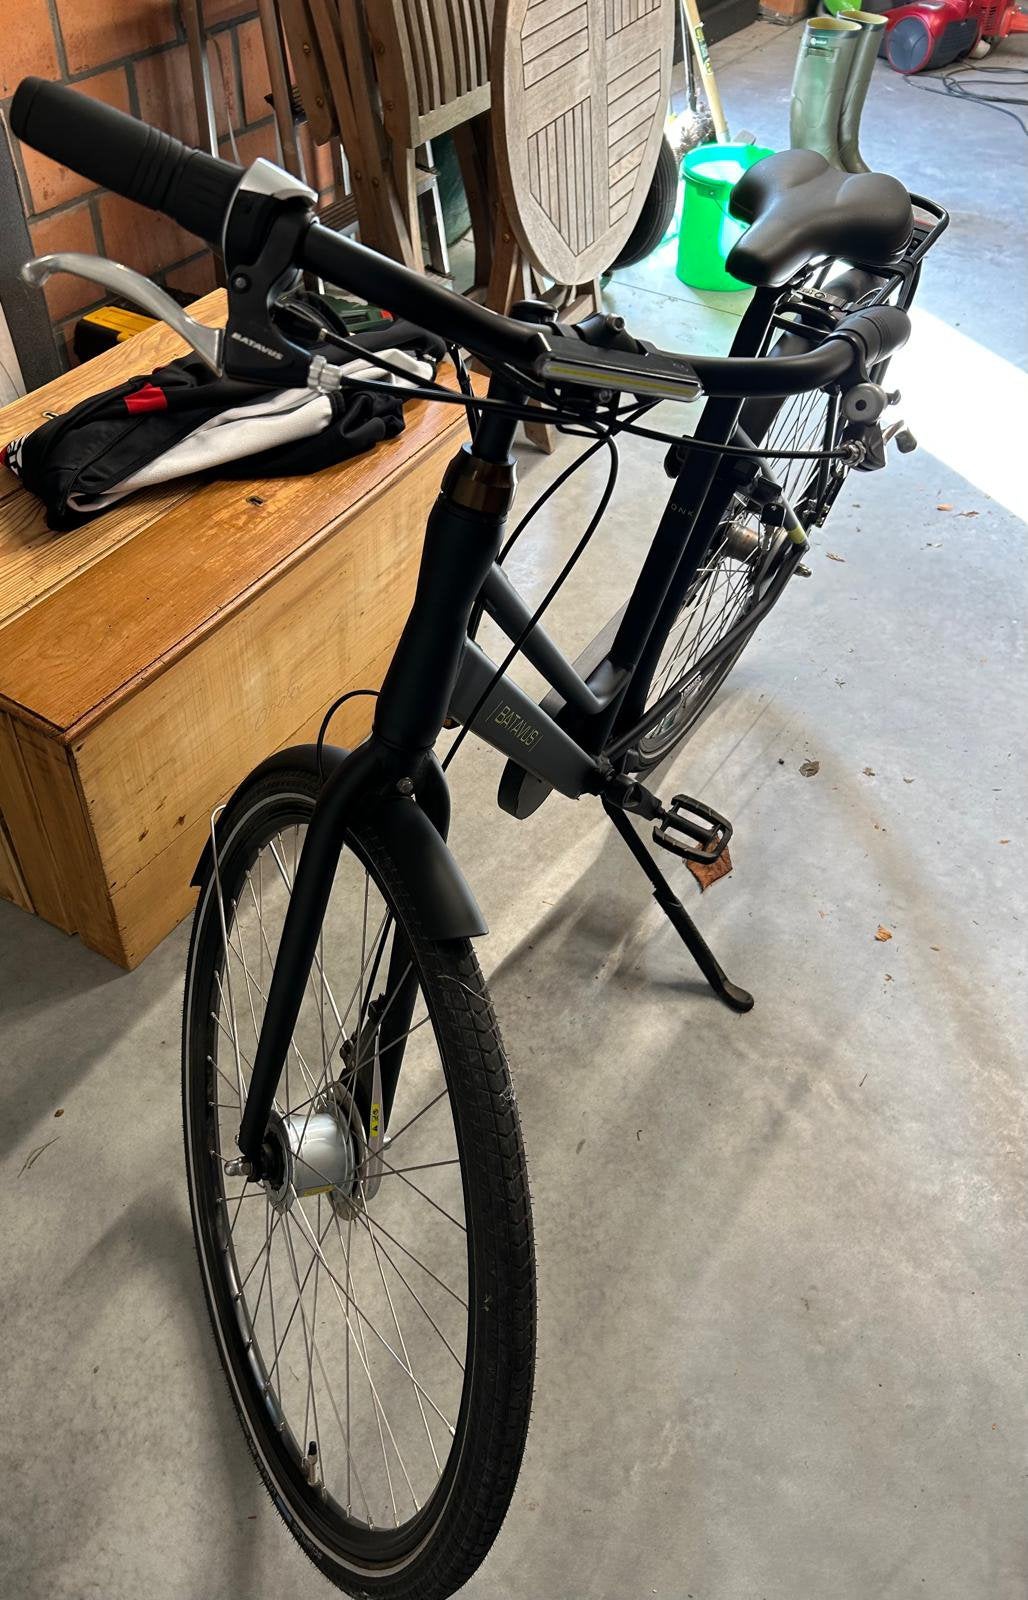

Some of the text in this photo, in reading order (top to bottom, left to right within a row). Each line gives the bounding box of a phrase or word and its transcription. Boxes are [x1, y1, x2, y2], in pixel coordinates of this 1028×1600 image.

[232, 332, 283, 360] BATAVUS
[669, 502, 694, 517] ONK
[495, 705, 539, 746] BATAVUS
